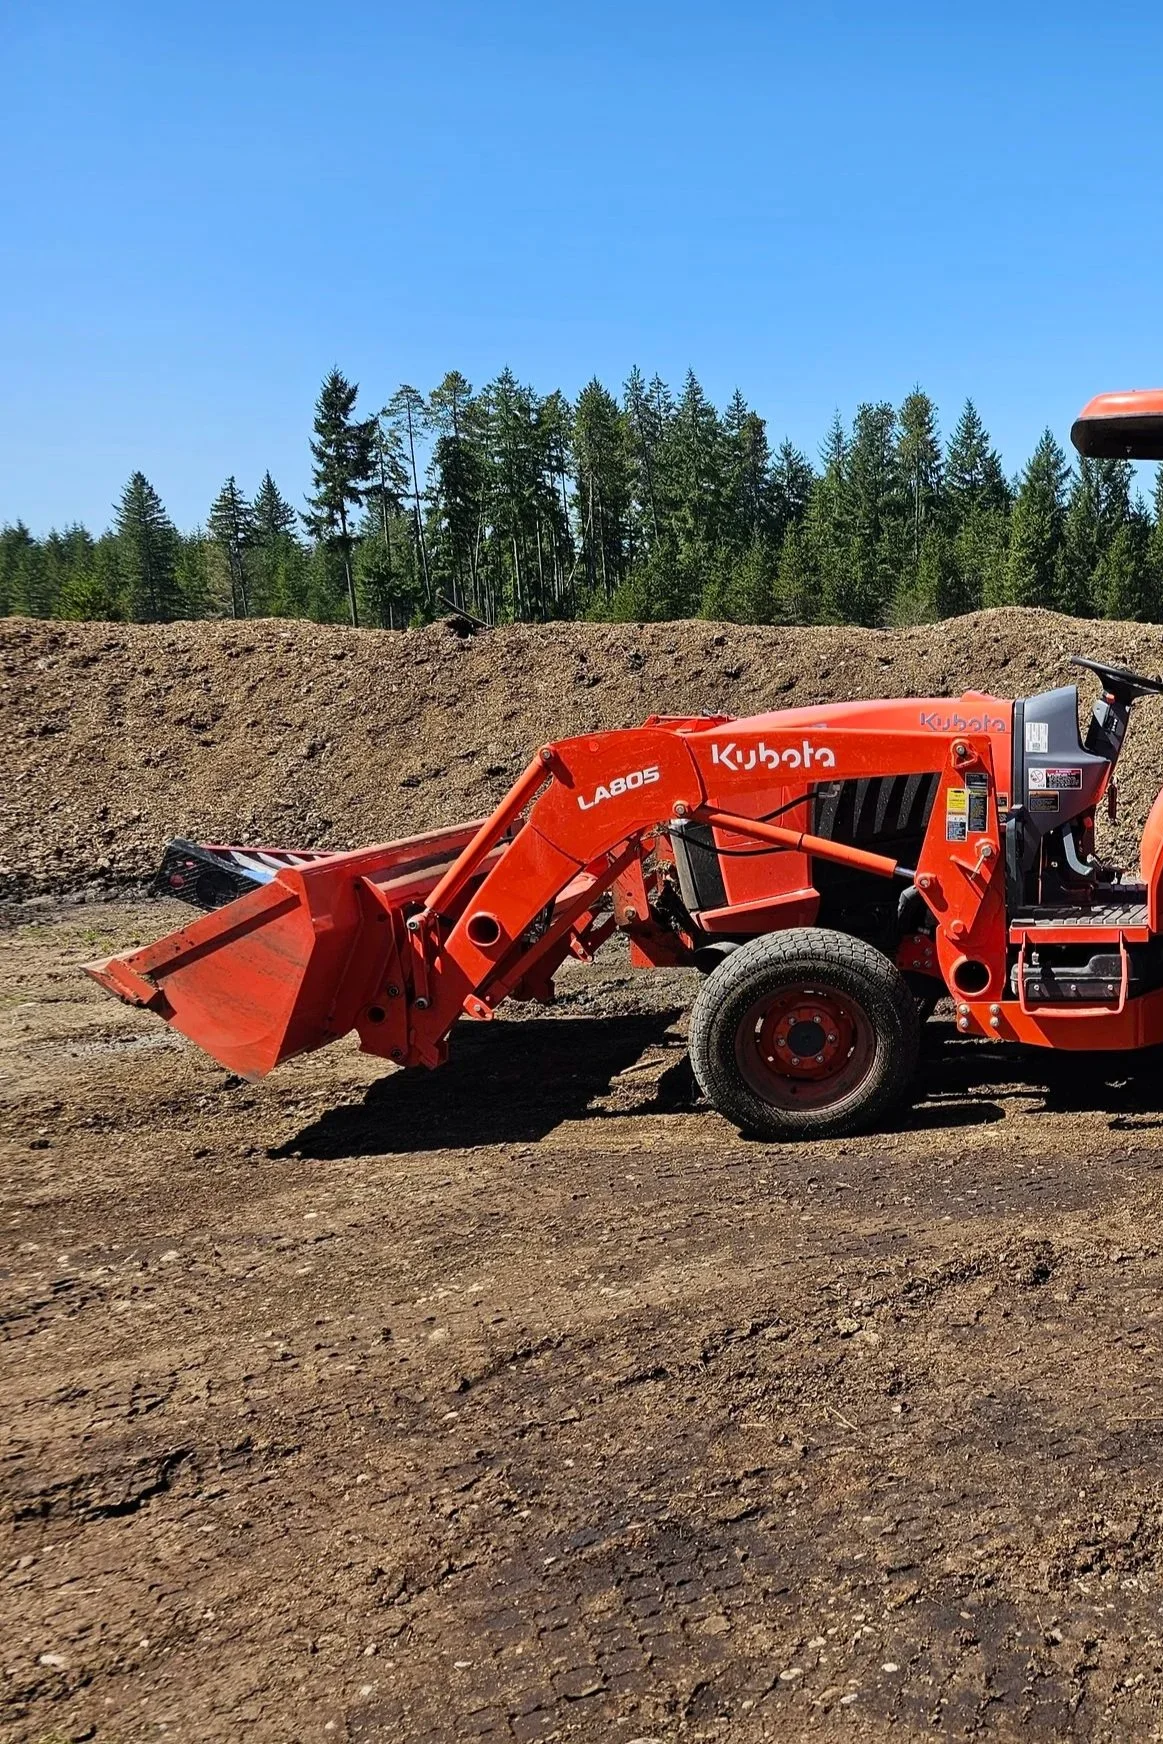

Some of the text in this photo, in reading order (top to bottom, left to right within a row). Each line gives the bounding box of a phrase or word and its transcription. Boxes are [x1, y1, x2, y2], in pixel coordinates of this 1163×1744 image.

[920, 712, 1006, 732] Kubota
[711, 740, 836, 771] Kubota
[577, 765, 660, 811] LA805
